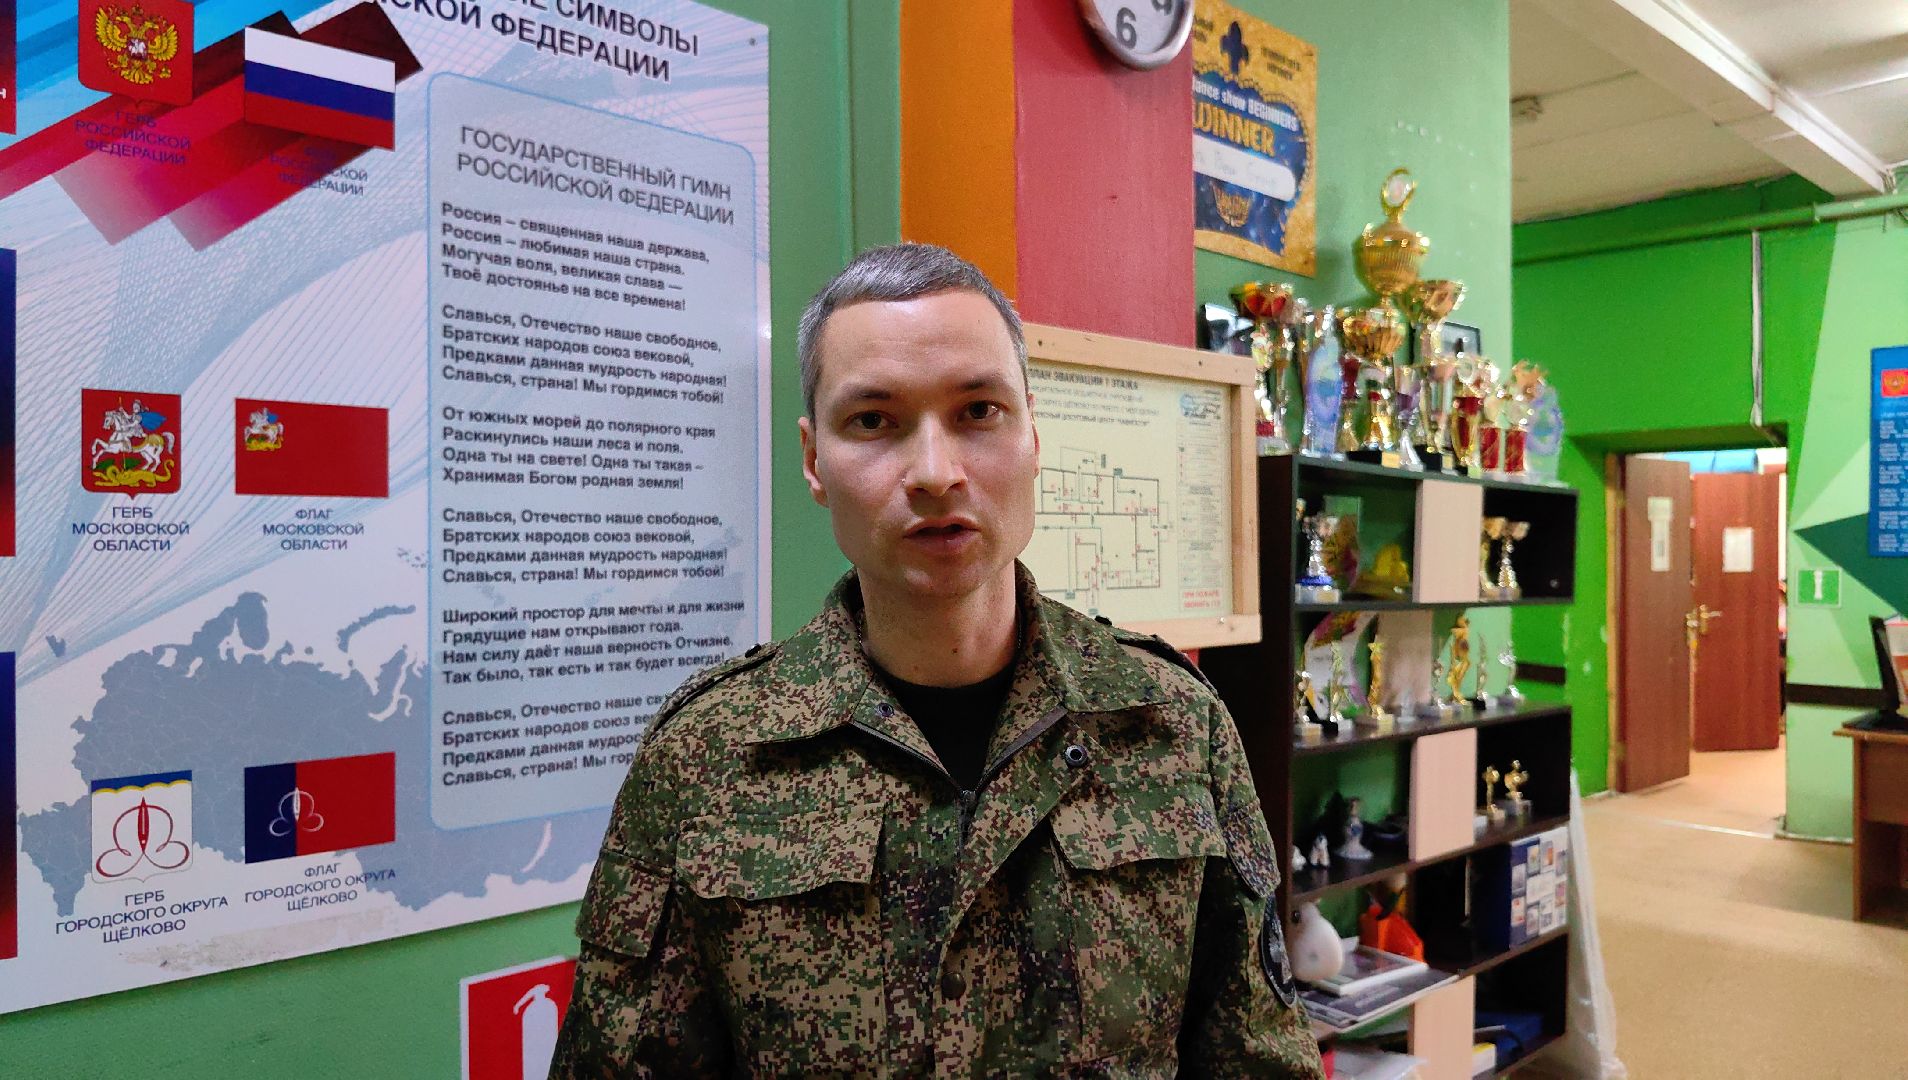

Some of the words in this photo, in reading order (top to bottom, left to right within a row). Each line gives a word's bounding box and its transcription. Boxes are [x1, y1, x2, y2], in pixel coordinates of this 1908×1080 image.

[556, 0, 698, 56] СИМВОЛЫ
[1116, 7, 1137, 49] 6
[491, 12, 669, 82] ФЕДЕРАЦИИ
[115, 111, 157, 128] ГЕРБ
[75, 120, 191, 150] РОССИЙСКОЙ
[85, 139, 185, 165] ФЕДЕРАЦИИ
[461, 126, 675, 189] ГОСУДАРСТВЕННЫЙ
[681, 176, 731, 201] ГИМН
[457, 153, 612, 199] РОССИЙСКОЙ
[618, 187, 734, 226] ФЕДЕРАЦИИ
[442, 201, 502, 226] Россия
[520, 218, 603, 243] священная
[607, 233, 644, 251] наша
[648, 241, 710, 264] держава,
[442, 221, 502, 245] Россия
[520, 238, 589, 262] любимая
[594, 250, 631, 266] наша
[635, 257, 685, 275] страна.
[442, 241, 512, 267] Могучая
[516, 256, 557, 276] воля,
[561, 263, 621, 284] великая
[625, 274, 665, 290] слава
[442, 262, 482, 282] Твоё
[486, 272, 569, 294] достоянье
[573, 284, 591, 297] на
[594, 287, 619, 301] все
[623, 291, 686, 311] времена!
[442, 303, 516, 329] Славься,
[520, 313, 600, 337] Отечество
[605, 327, 642, 342] наше
[646, 332, 721, 353] свободное,
[442, 323, 520, 347] Братских
[524, 336, 589, 355] народов
[593, 343, 630, 359] союз
[634, 347, 694, 368] вековой,
[442, 344, 525, 367] Предками
[530, 356, 584, 372] данная
[588, 361, 656, 380] мудрость
[661, 370, 727, 387] народная!
[442, 364, 516, 388] Славься,
[521, 375, 577, 391] страна!
[583, 378, 607, 393] Мы
[611, 378, 678, 400] гордимся
[681, 384, 724, 404] тобой!
[443, 405, 465, 421] От
[469, 410, 528, 428] южных
[533, 414, 581, 431] морей
[585, 417, 604, 433] до
[608, 419, 682, 437] полярного
[685, 424, 715, 440] края
[443, 426, 548, 448] Раскинулись
[553, 435, 593, 448] наши
[597, 438, 631, 451] леса
[635, 437, 643, 451] и
[647, 441, 684, 454] поля.
[443, 446, 487, 464] Одна
[491, 451, 512, 464] ты
[517, 453, 535, 465] на
[540, 454, 587, 467] свете!
[591, 454, 629, 471] Одна
[633, 456, 651, 470] ты
[654, 460, 692, 472] такая
[443, 465, 525, 485] Хранимая
[529, 469, 577, 486] Богом
[582, 473, 633, 489] родная
[638, 474, 684, 490] земля!
[72, 520, 190, 535] МОСКОВСКОЙ
[112, 507, 153, 519] ГЕРБ
[295, 508, 333, 520] ФЛАГ
[443, 508, 516, 525] Славься,
[521, 508, 601, 527] Отечество
[606, 513, 643, 525] наше
[647, 512, 722, 527] свободное,
[263, 522, 364, 536] МОСКОВСКОЙ
[443, 528, 520, 546] Братских
[525, 530, 590, 546] народов
[594, 532, 631, 543] союз
[635, 529, 695, 546] вековой,
[93, 539, 171, 552] ОБЛАСТИ
[281, 539, 347, 551] ОБЛАСТИ
[443, 548, 525, 566] Предками
[530, 550, 584, 564] данная
[589, 550, 657, 564] мудрость
[661, 547, 728, 564] народная!
[443, 568, 516, 585] Славься,
[521, 567, 578, 584] страна!
[584, 566, 607, 580] Мы
[611, 567, 678, 582] гордимся
[682, 564, 724, 581] тобой!
[443, 606, 518, 626] Широкий
[522, 603, 584, 624] простор
[589, 603, 615, 621] для
[619, 601, 662, 617] мечты
[667, 603, 674, 616] и
[678, 600, 702, 616] для
[706, 600, 744, 614] жизни
[443, 624, 526, 647] Грядущие
[531, 628, 561, 639] нам
[565, 623, 646, 641] открывают
[650, 621, 684, 635] года.
[443, 650, 477, 664] Нам
[482, 648, 520, 663] силу
[524, 644, 560, 662] даёт
[564, 640, 603, 658] наша
[607, 636, 672, 656] верность
[675, 632, 734, 650] Отчизне.
[443, 670, 471, 685] Так
[476, 667, 524, 683] было,
[529, 664, 554, 679] так
[558, 664, 591, 678] есть
[595, 662, 604, 673] и
[608, 660, 631, 672] так
[635, 655, 674, 673] будет
[678, 652, 725, 666] всегда!
[443, 708, 516, 726] Славься,
[521, 700, 600, 719] Отечество
[605, 696, 642, 709] наше
[443, 727, 520, 747] Братских
[525, 720, 589, 738] народов
[593, 716, 631, 730] союз
[443, 746, 526, 768] Предками
[530, 740, 584, 759] данная
[588, 729, 642, 751] мудрос
[443, 767, 516, 787] Славься,
[521, 756, 577, 778] страна!
[583, 754, 607, 768] Мы
[304, 863, 342, 878] ФЛАГ
[124, 888, 165, 907] ГЕРБ
[244, 879, 342, 903] ГОРОДСКОГО
[344, 869, 396, 887] ОКРУГА
[287, 889, 358, 912] ЩЁЛКОВО
[55, 905, 167, 935] ГОРОДСКОГО
[167, 896, 229, 916] ОКРУГА
[103, 919, 187, 944] ЩЁЛКОВО
